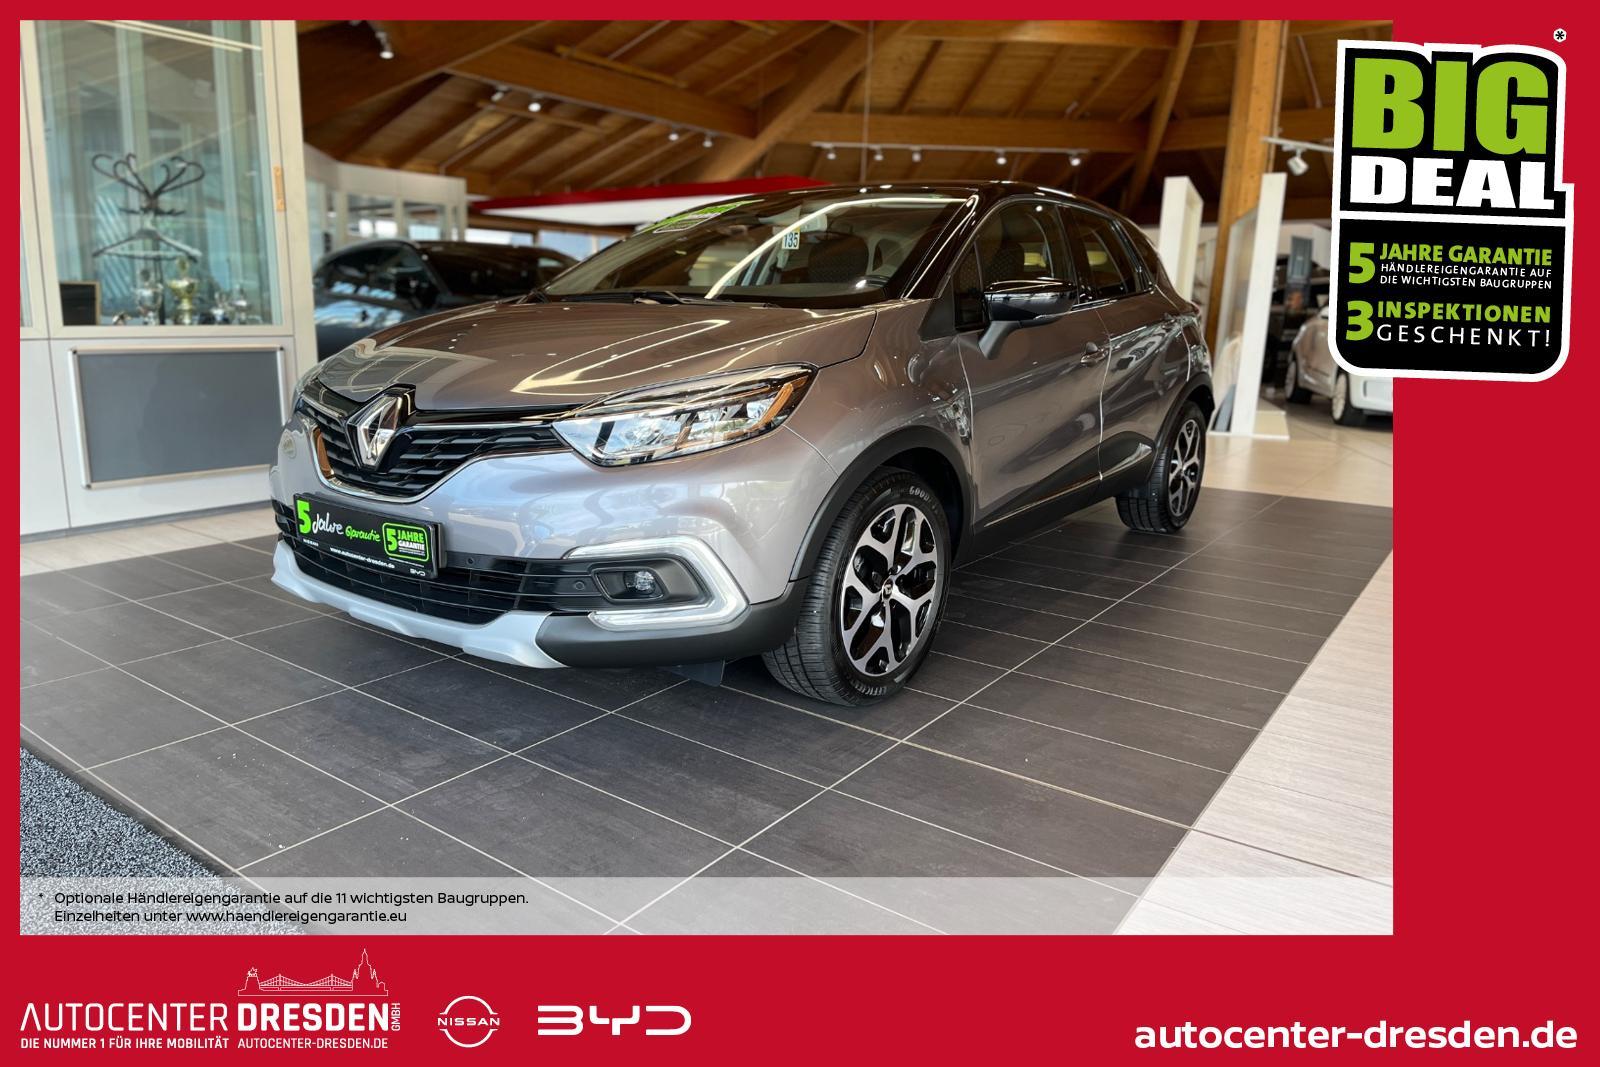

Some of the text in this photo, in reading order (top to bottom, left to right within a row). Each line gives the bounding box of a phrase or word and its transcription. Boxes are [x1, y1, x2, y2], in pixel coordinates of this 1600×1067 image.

[784, 232, 798, 248] 135
[297, 500, 311, 534] 5
[312, 512, 344, 534] Jahre
[386, 528, 424, 551] 5 JAHRE
